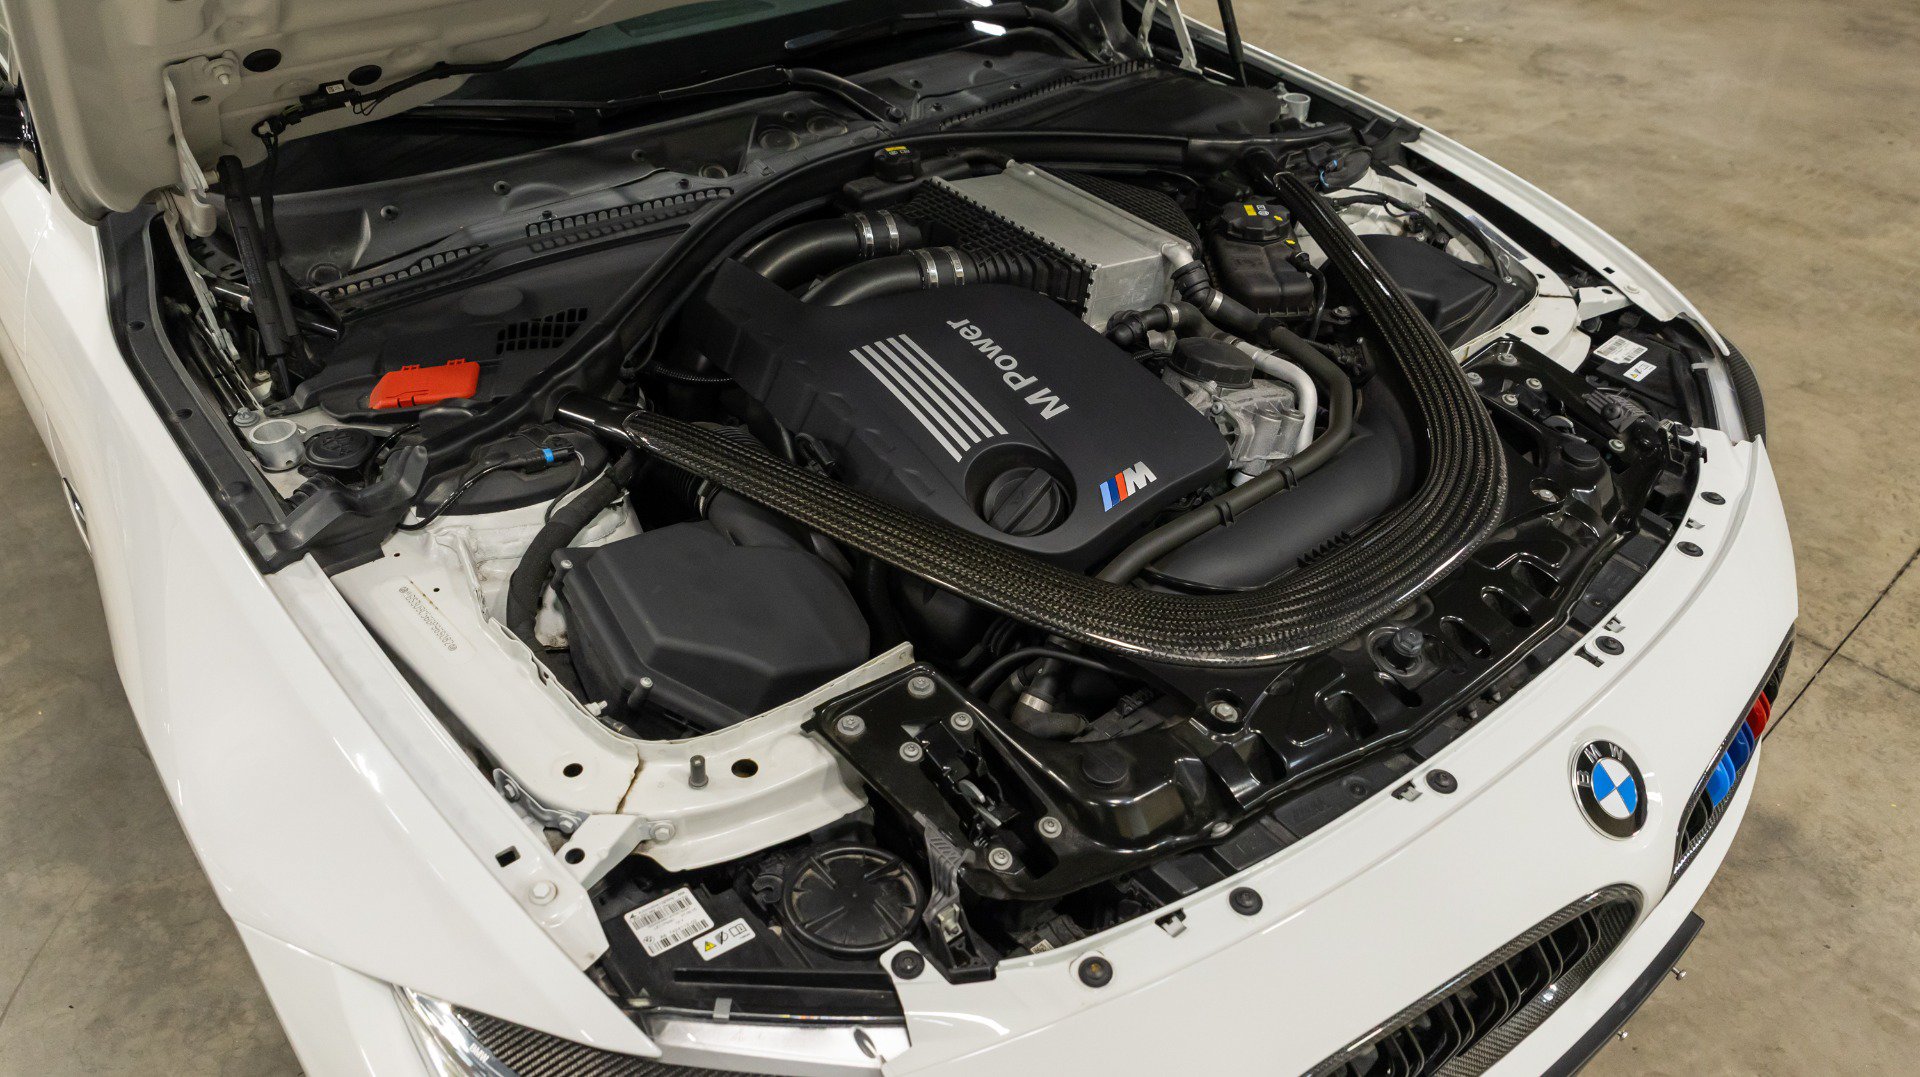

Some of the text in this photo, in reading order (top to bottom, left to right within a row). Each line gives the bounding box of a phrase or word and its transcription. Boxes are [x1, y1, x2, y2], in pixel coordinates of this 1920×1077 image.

[946, 318, 1070, 420] M Power
[1121, 460, 1157, 497] M
[1576, 742, 1624, 788] BMW
